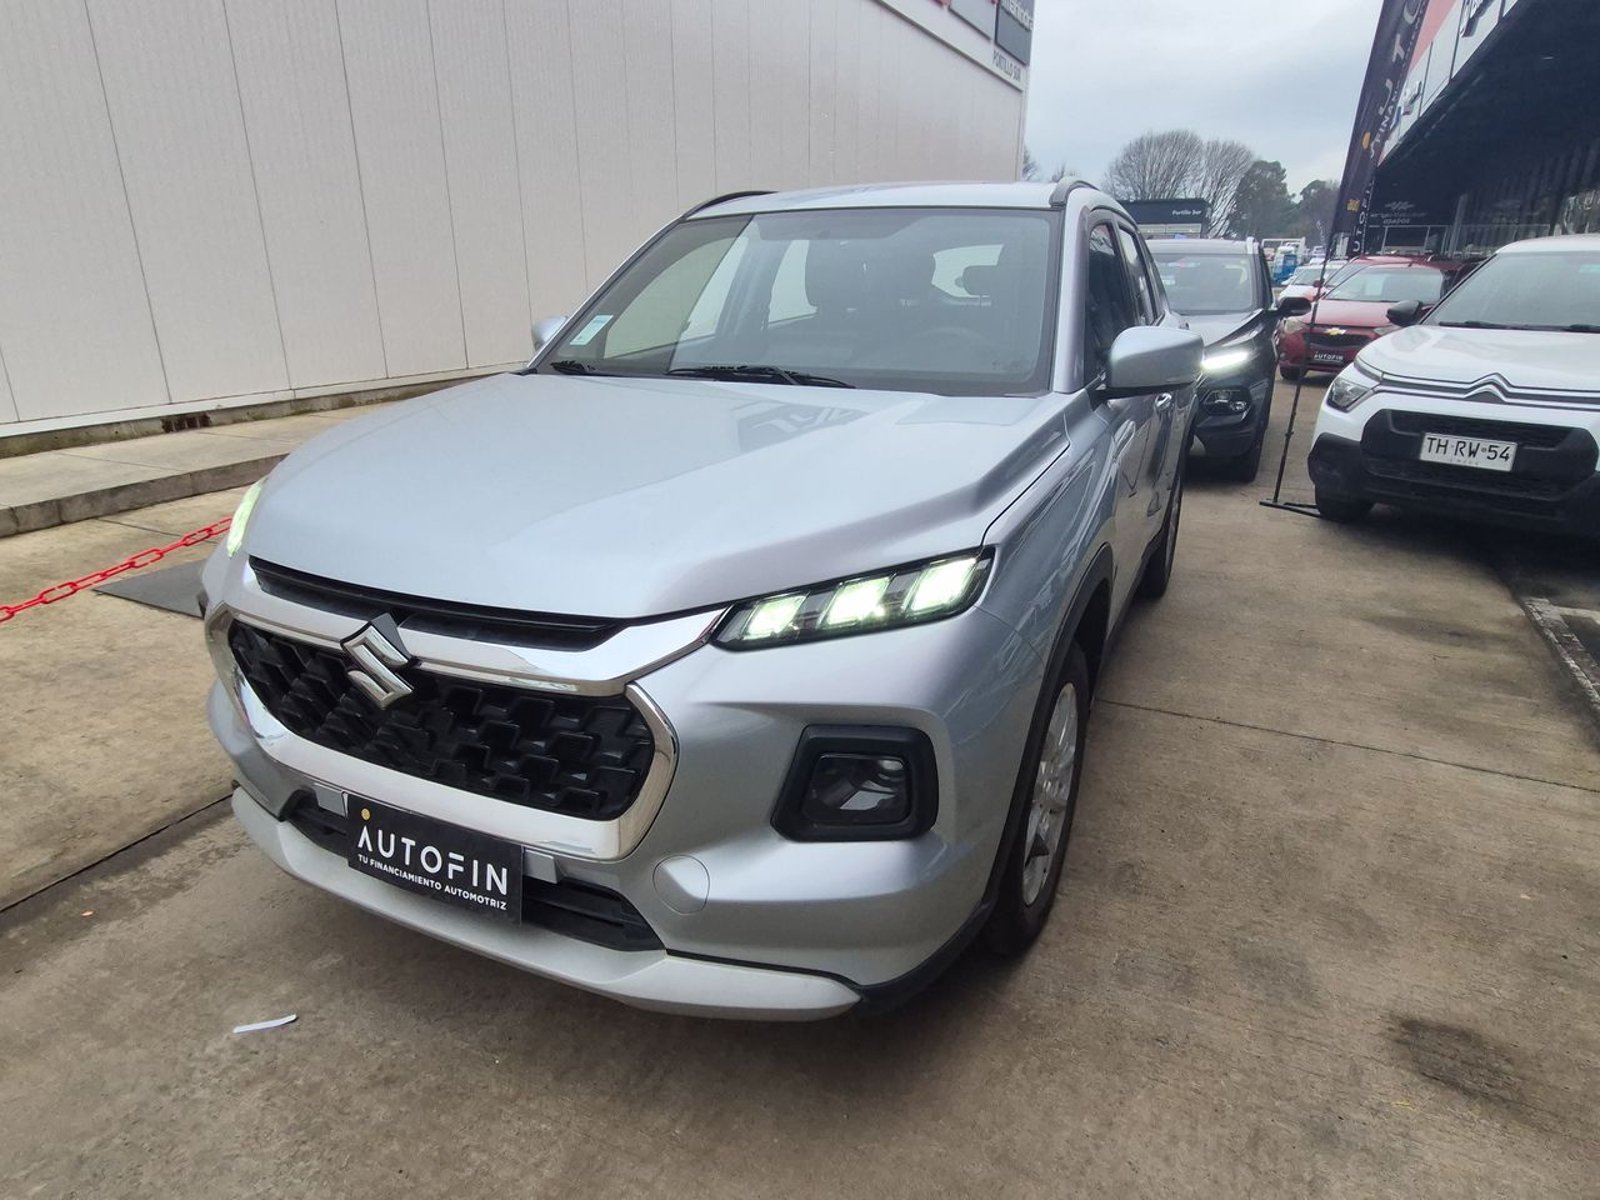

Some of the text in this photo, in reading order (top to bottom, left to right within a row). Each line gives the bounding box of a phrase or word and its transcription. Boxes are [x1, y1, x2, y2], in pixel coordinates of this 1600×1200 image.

[1427, 437, 1449, 455] TH
[1454, 440, 1480, 458] RW
[1487, 444, 1511, 462] 54
[357, 824, 508, 896] AUTOFIN
[358, 853, 507, 911] TU FINANCIAMIENTO AUTOMOTRIZ
